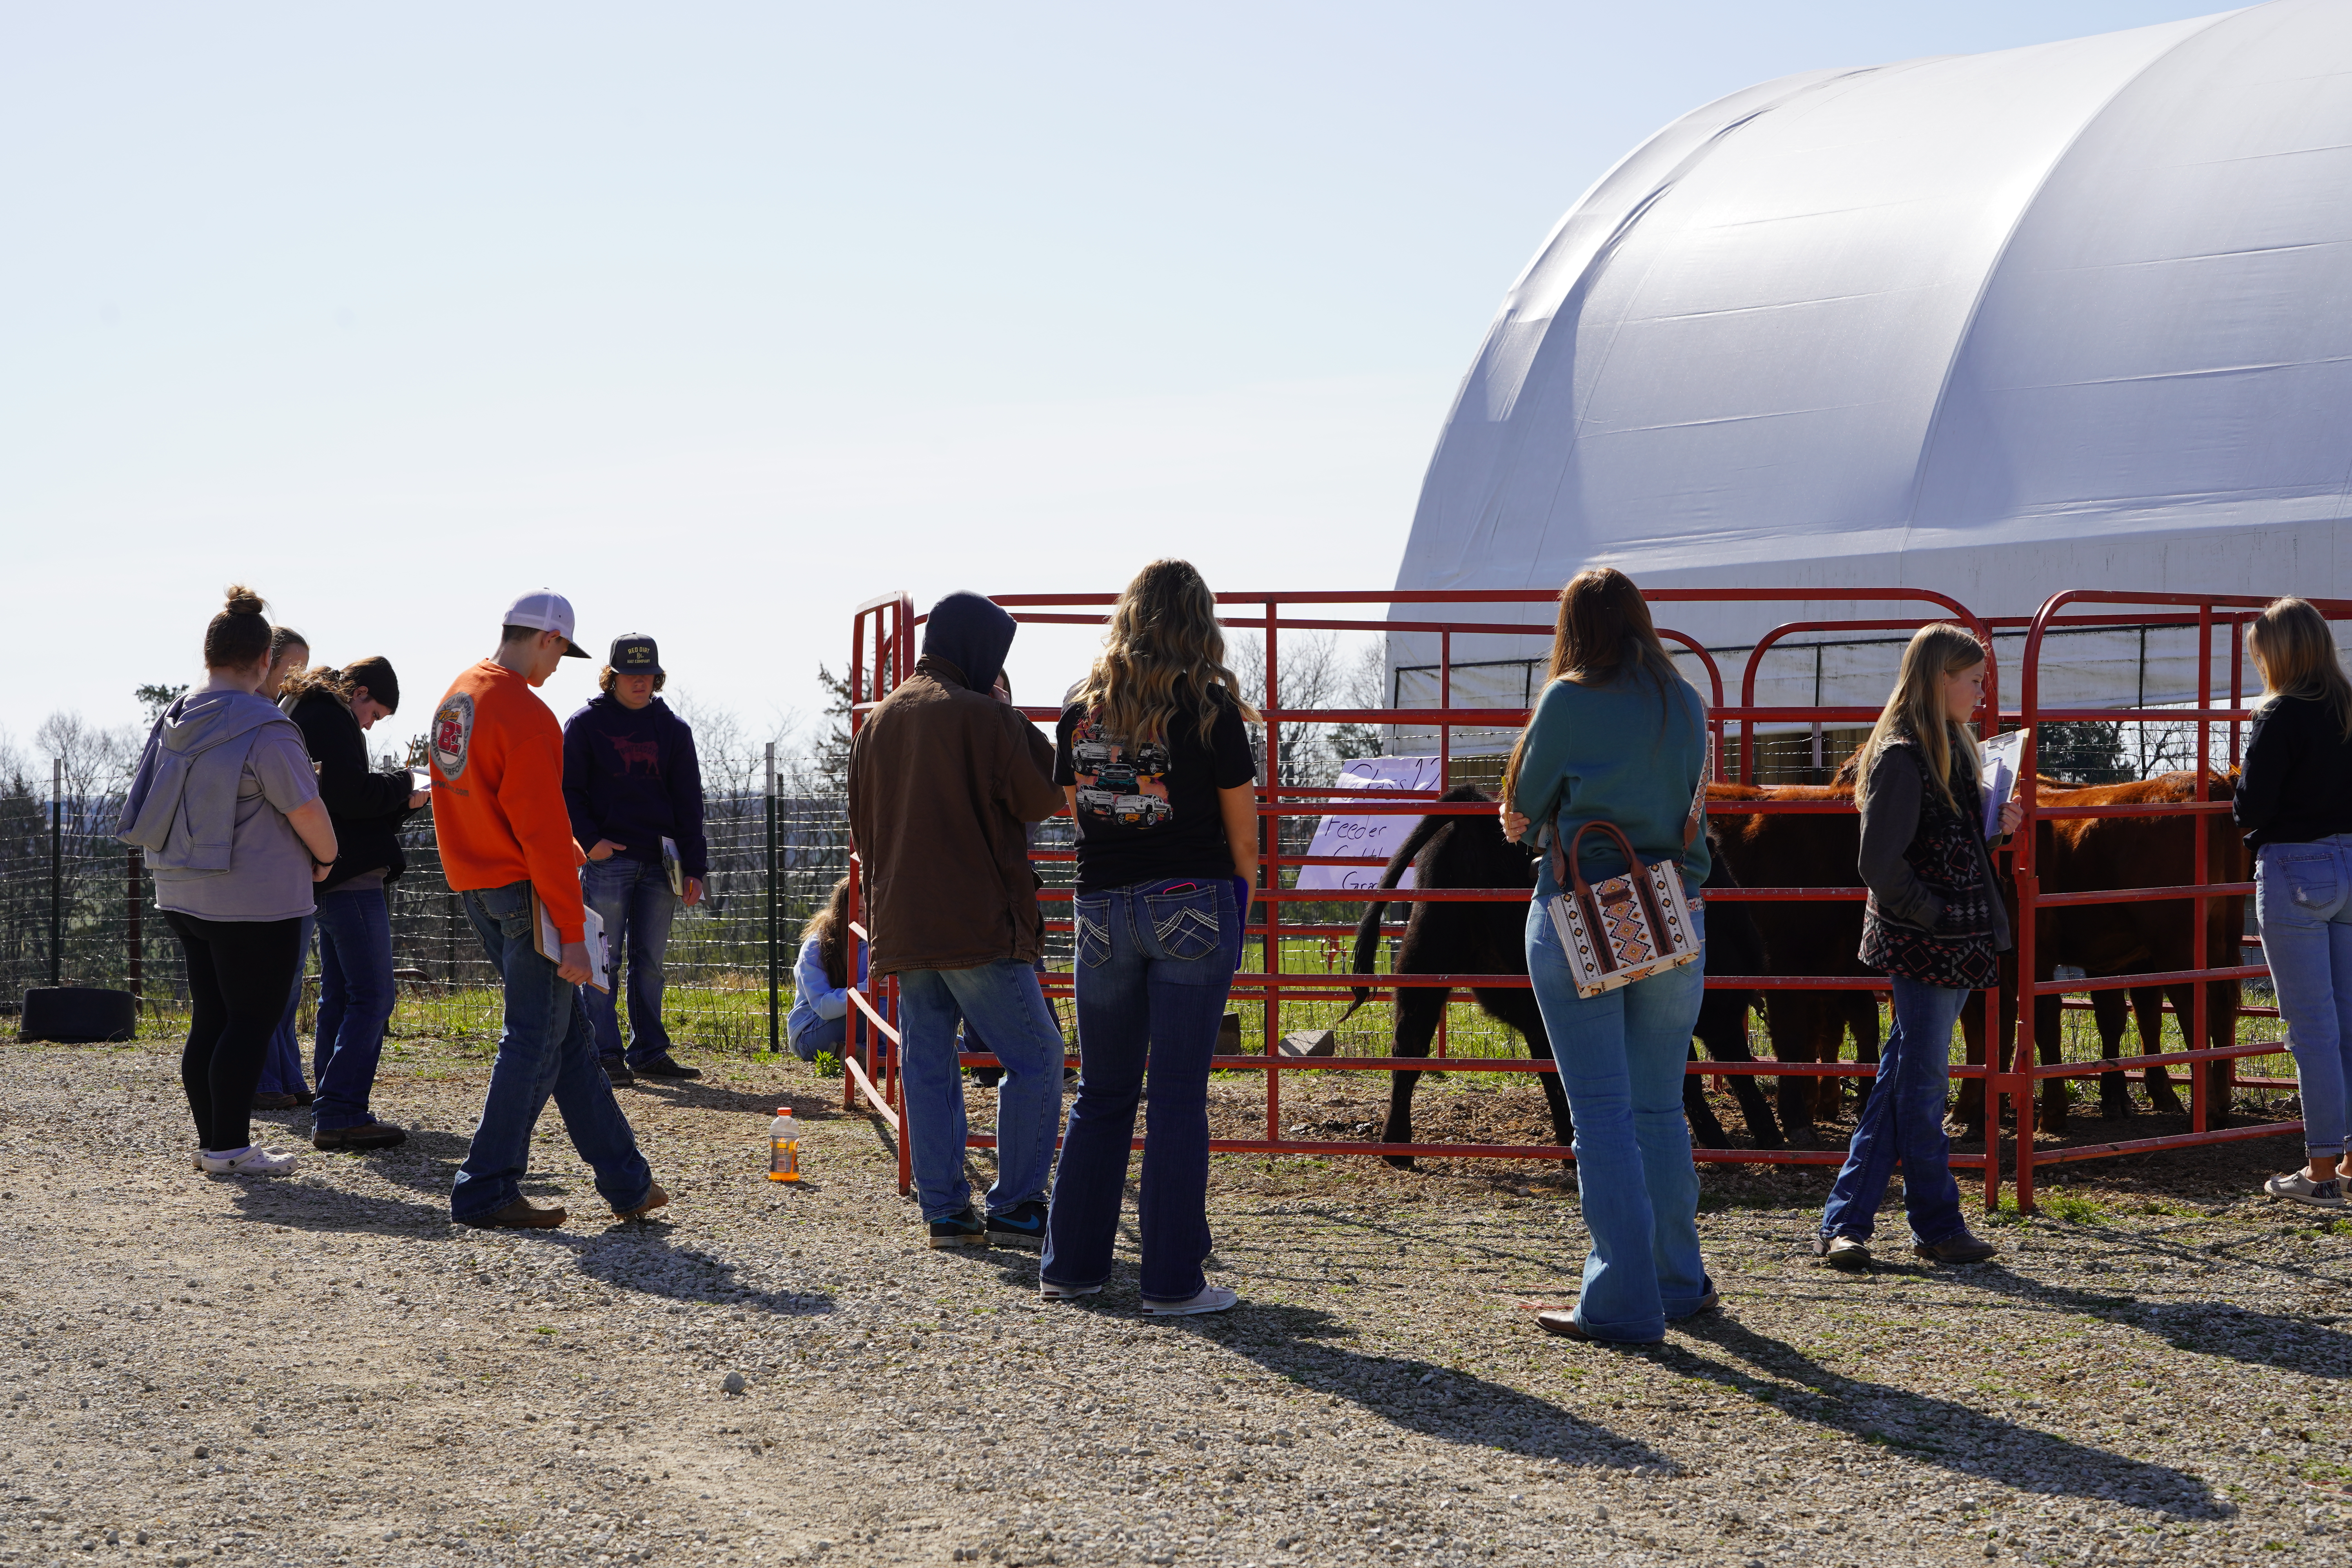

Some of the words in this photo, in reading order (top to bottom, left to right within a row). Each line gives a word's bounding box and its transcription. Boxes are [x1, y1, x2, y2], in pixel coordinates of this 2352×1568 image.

[443, 696, 472, 720] TEAMWORK
[443, 724, 470, 775] PERFORMNCE
[1325, 814, 1387, 840] Feeder
[1602, 891, 1628, 903] Wrangler
